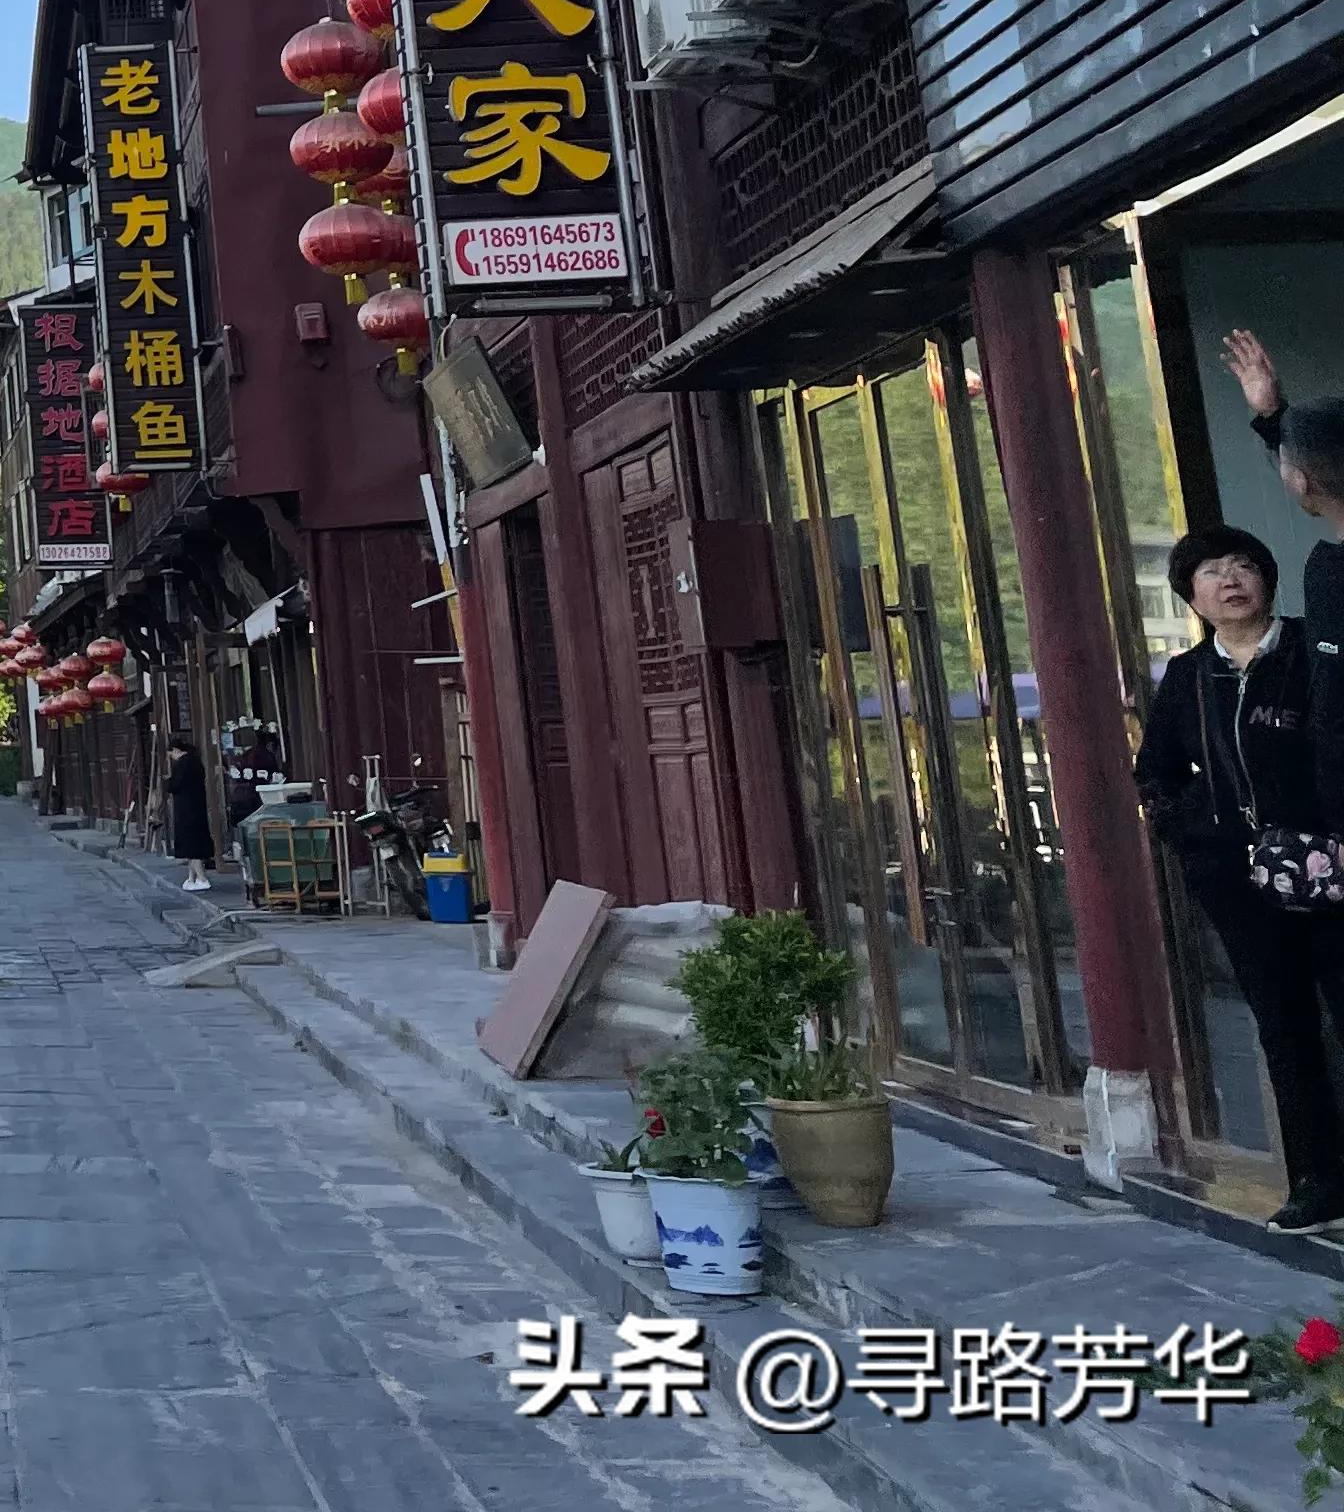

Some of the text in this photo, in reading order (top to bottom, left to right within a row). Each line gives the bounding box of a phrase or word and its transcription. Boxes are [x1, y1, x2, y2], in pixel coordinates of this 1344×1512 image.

[101, 59, 192, 458] 老地方木桶鱼
[479, 221, 616, 248] 18691645673
[483, 249, 620, 276] 15591462686
[34, 313, 97, 537] 根据地酒店
